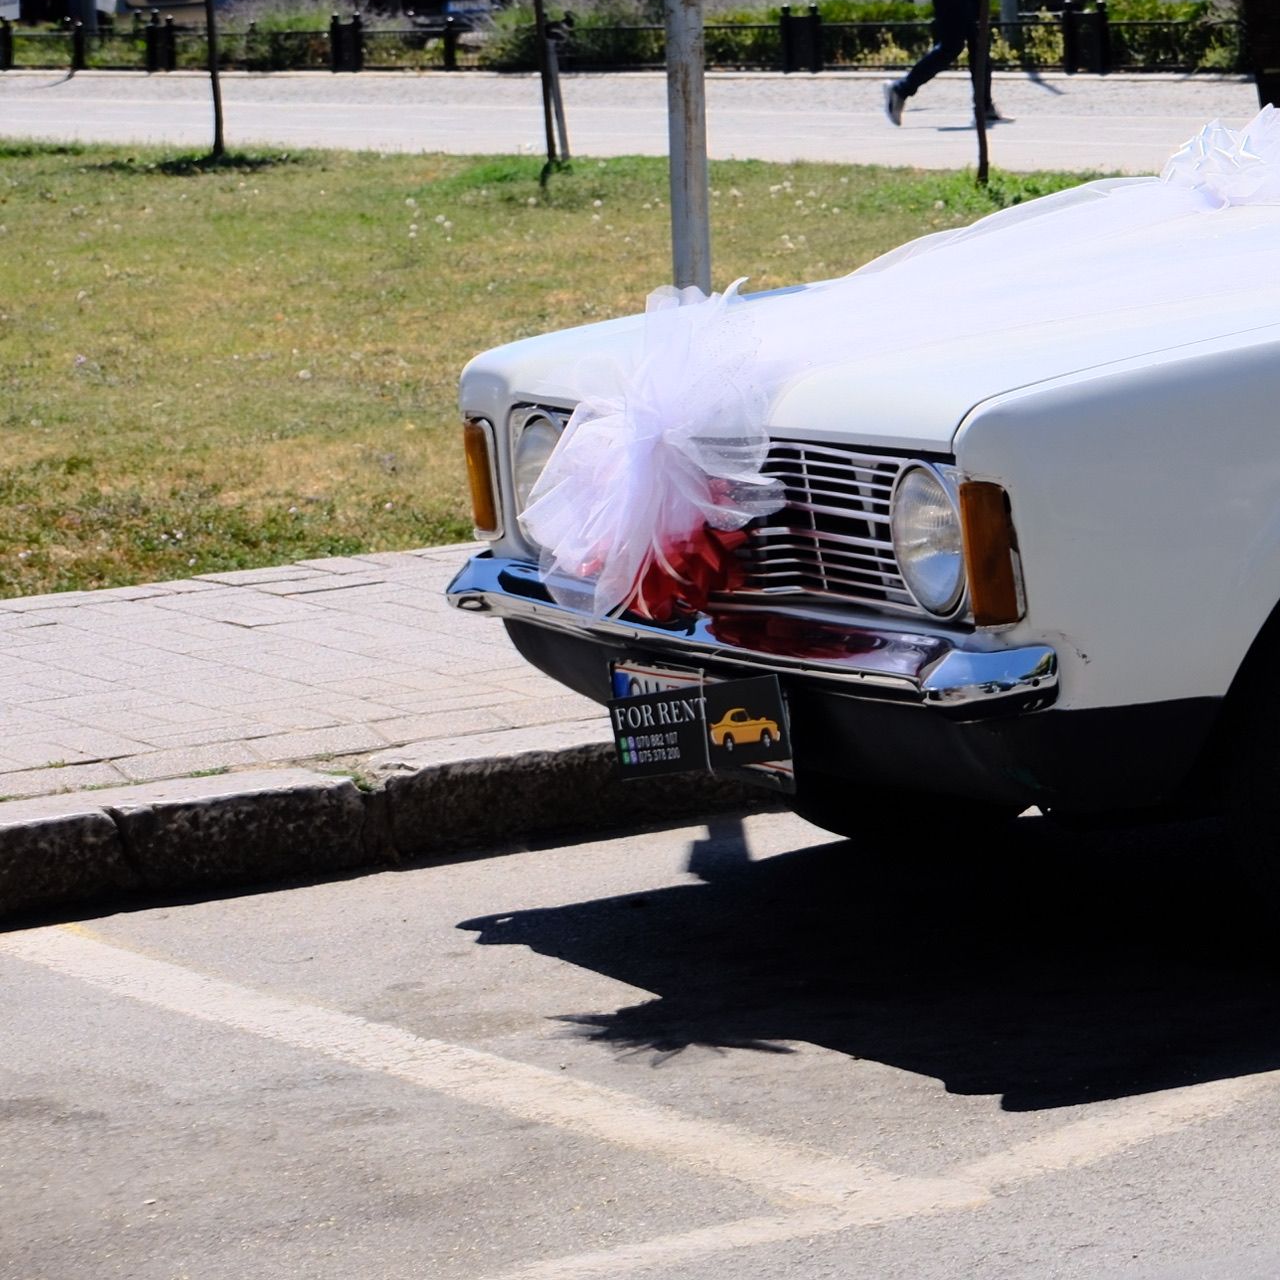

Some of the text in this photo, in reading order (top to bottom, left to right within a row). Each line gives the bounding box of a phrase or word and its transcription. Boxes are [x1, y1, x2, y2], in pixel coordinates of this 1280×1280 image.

[613, 697, 707, 731] FOR RENT
[636, 734, 650, 748] 070
[665, 731, 678, 744] 107
[638, 749, 653, 763] 075
